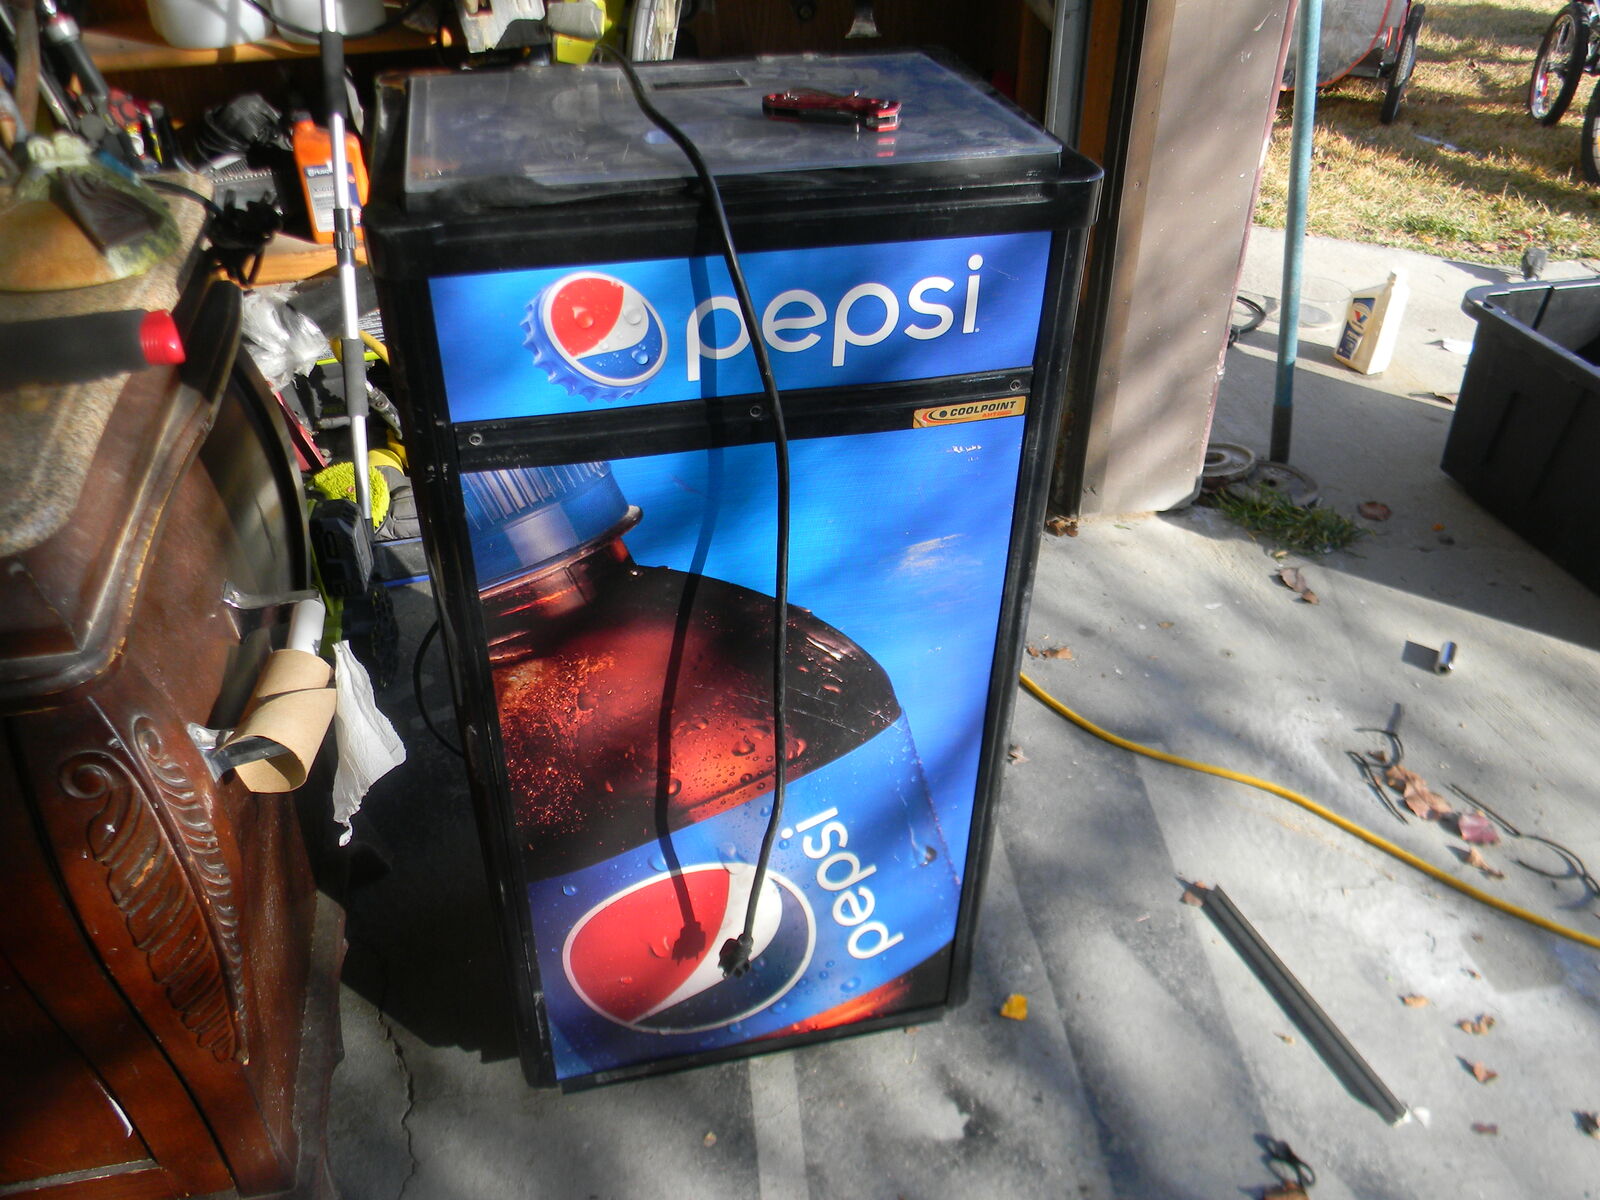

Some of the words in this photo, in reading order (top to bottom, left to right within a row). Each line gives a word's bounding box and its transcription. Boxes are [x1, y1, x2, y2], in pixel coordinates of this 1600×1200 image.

[686, 254, 984, 382] pepsi
[949, 401, 1017, 417] COOLPOINT
[780, 807, 905, 960] pepsi
